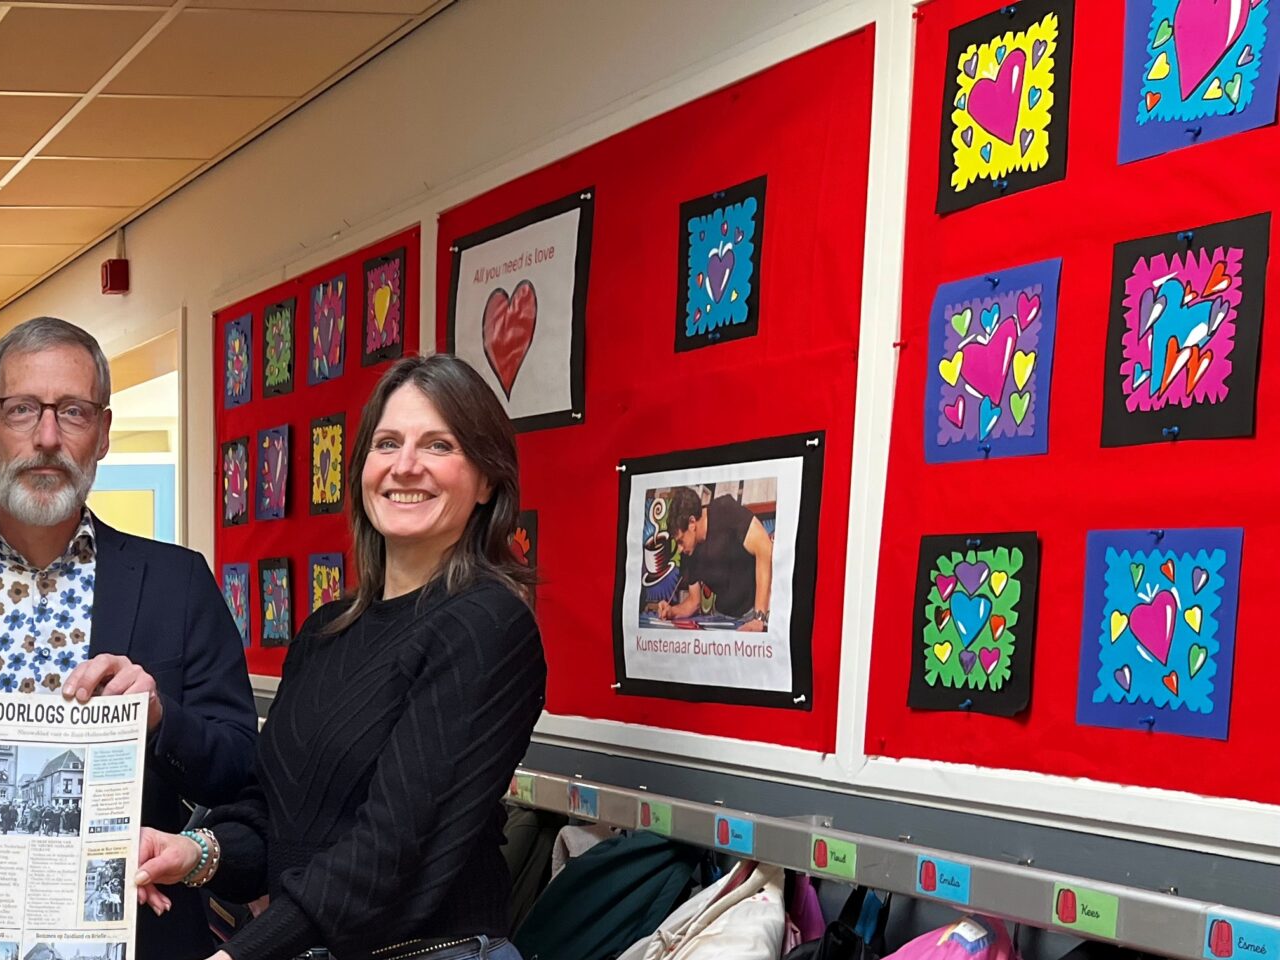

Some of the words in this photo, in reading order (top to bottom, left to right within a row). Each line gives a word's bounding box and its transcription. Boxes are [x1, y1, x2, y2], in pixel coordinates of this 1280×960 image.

[473, 267, 485, 283] All
[485, 265, 501, 284] you
[502, 253, 524, 274] need
[524, 253, 533, 266] is
[534, 246, 555, 264] love
[636, 635, 691, 654] Kunstenaar
[693, 638, 731, 656] Burton
[734, 640, 773, 659] Morris
[70, 701, 141, 725] COURANT
[1080, 903, 1100, 919] Kees
